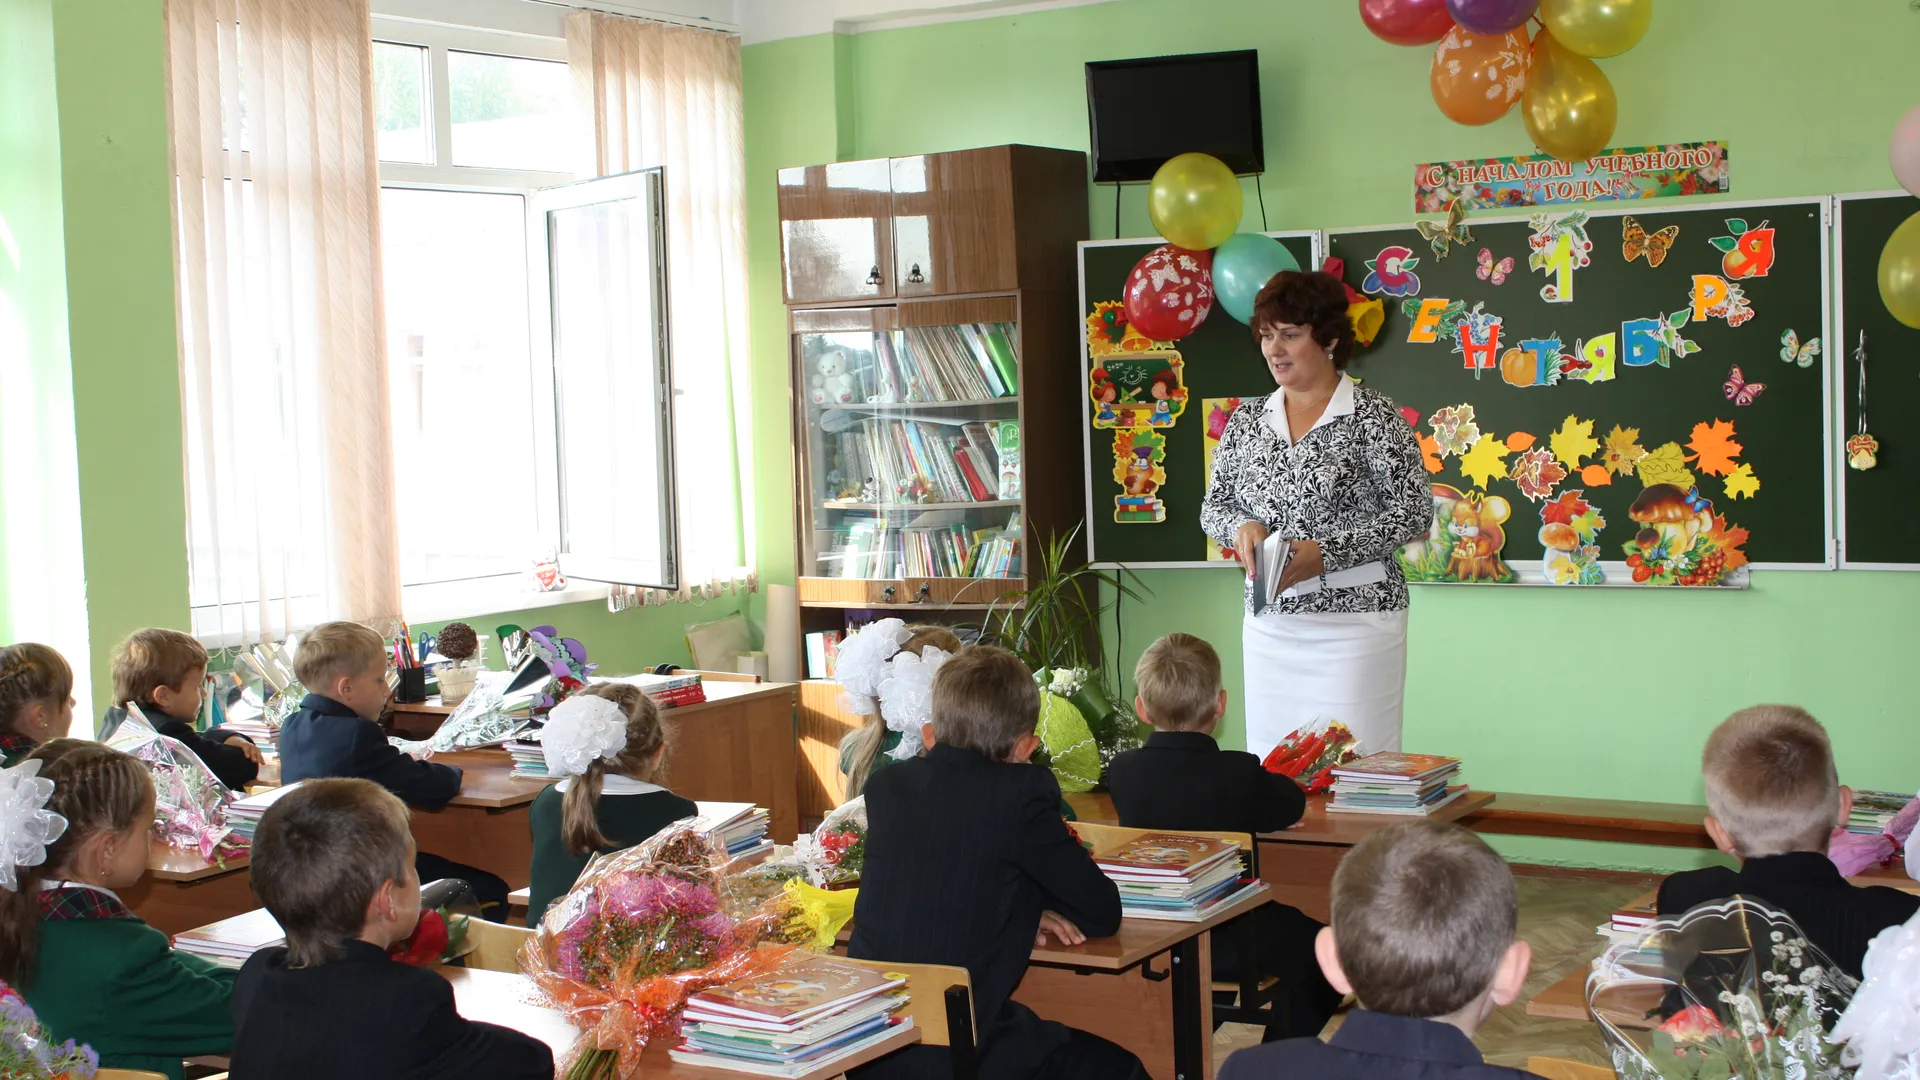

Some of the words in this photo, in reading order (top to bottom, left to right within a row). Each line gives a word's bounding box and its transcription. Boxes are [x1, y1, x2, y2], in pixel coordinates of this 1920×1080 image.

[1426, 165, 1445, 187] С
[1457, 160, 1574, 184] НАЧАЛОМ
[1584, 148, 1713, 175] УЧЕБНОГО
[1543, 179, 1614, 202] ГОДА!
